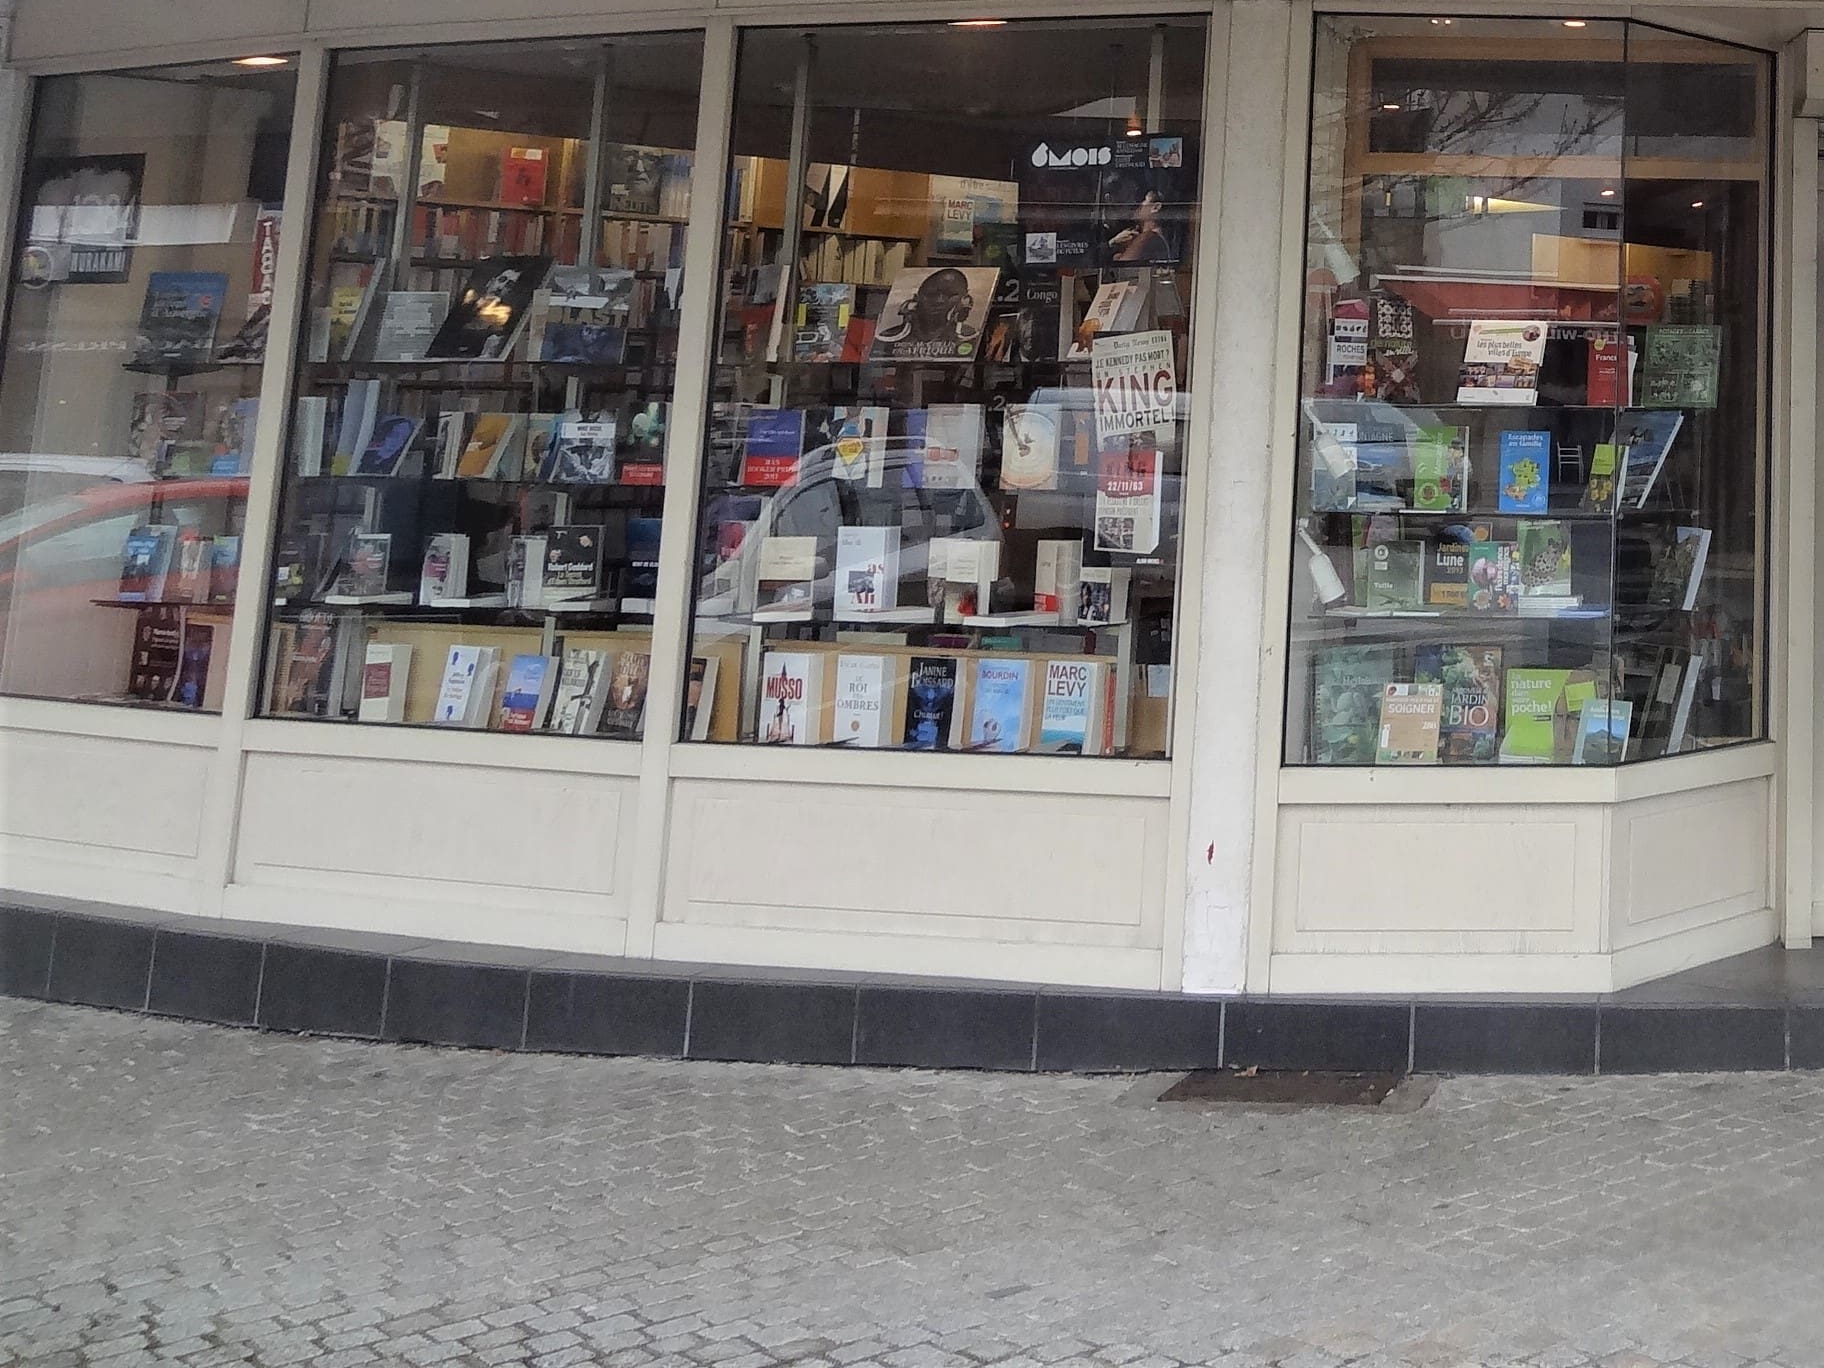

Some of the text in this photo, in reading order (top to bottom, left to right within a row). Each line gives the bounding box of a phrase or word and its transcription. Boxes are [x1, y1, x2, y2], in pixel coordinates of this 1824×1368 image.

[947, 199, 973, 210] MARC
[947, 210, 973, 220] LEVY
[1026, 288, 1058, 305] Congo
[1336, 344, 1365, 354] ROCHES
[1106, 353, 1133, 367] KENNEDY
[1134, 352, 1147, 363] PAS
[1148, 350, 1164, 361] MORT
[1097, 370, 1174, 416] KING
[1507, 433, 1544, 443] Escapades
[1107, 480, 1143, 492] 22/11/63
[1436, 553, 1464, 566] Lune
[918, 660, 948, 677] JANINE
[1049, 665, 1087, 682] MARC
[982, 670, 1019, 681] BOURDIN
[766, 677, 803, 700] MUSSO
[849, 682, 868, 695] ROI
[1048, 682, 1087, 697] LEVY
[1510, 677, 1552, 690] nature
[837, 699, 879, 711] OMBRES
[1388, 703, 1435, 714] SOIGNER
[1449, 704, 1489, 727] BIO
